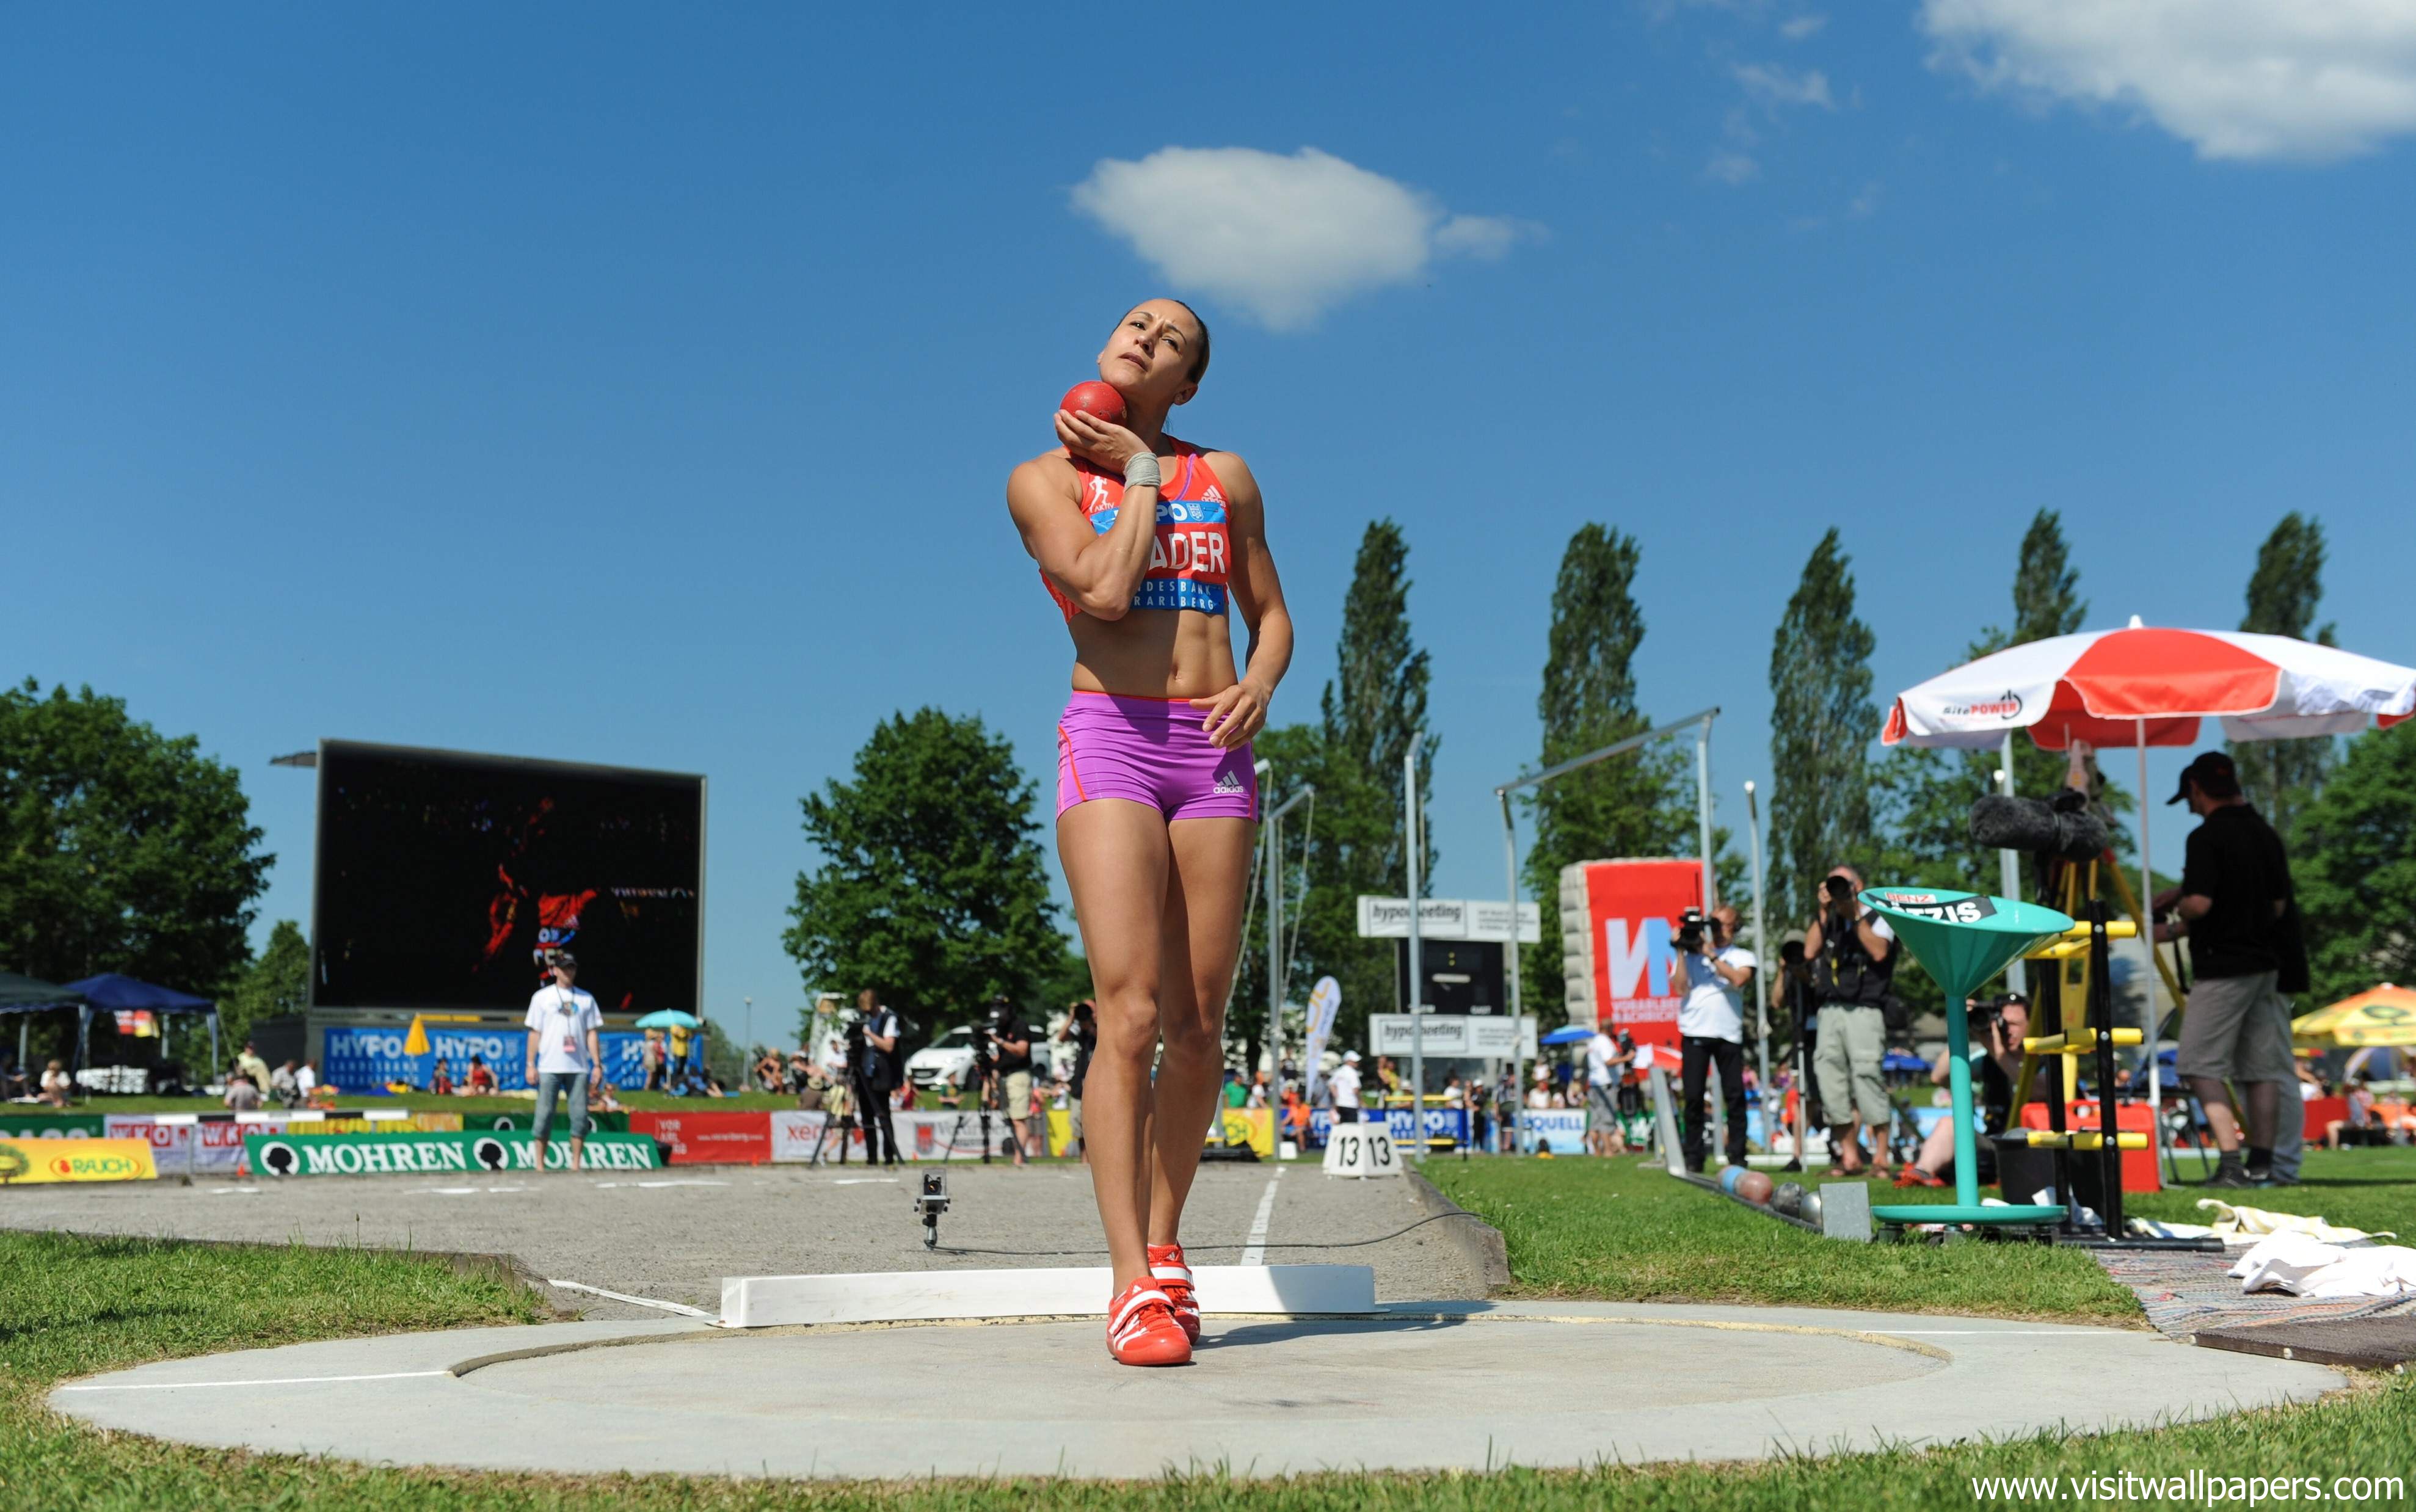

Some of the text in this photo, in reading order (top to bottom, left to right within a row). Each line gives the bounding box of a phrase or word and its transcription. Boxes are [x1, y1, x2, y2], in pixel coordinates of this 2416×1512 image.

[1094, 502, 1114, 513] AKTIV
[1156, 503, 1187, 521] PO
[1149, 531, 1225, 574] ADER
[1139, 581, 1211, 596] DESBANK
[1134, 596, 1213, 610] RARLBERG
[1213, 784, 1244, 794] adidas
[330, 1036, 402, 1059] HYPO
[435, 1036, 502, 1059] HYPO
[302, 1141, 467, 1173] MOHREN
[510, 1141, 653, 1171] MOHREN
[1339, 1137, 1359, 1166] 13
[1369, 1136, 1390, 1166] 13
